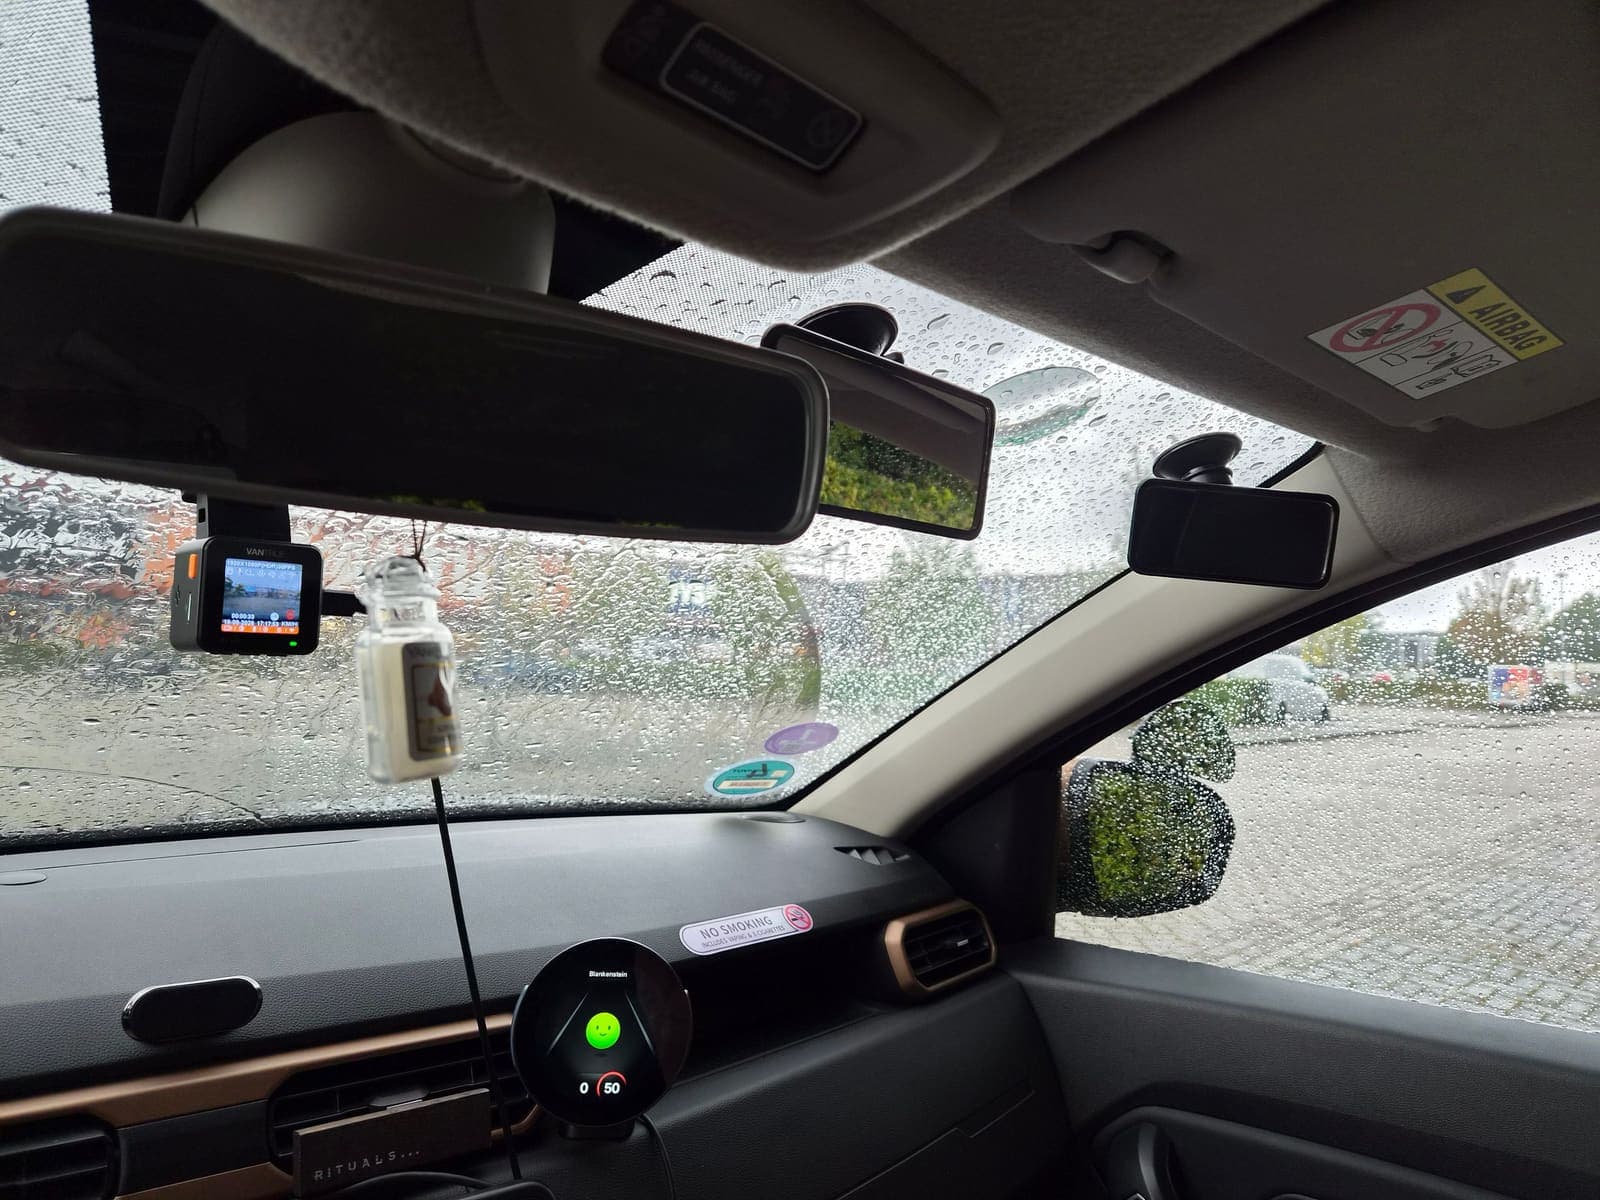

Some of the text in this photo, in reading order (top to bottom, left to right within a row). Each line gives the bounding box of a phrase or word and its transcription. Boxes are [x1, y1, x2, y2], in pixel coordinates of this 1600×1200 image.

[1468, 302, 1548, 351] AIRBAG
[700, 916, 773, 940] NO SMOKING
[588, 970, 628, 978] Blankenstein
[579, 1082, 621, 1094] 0 50
